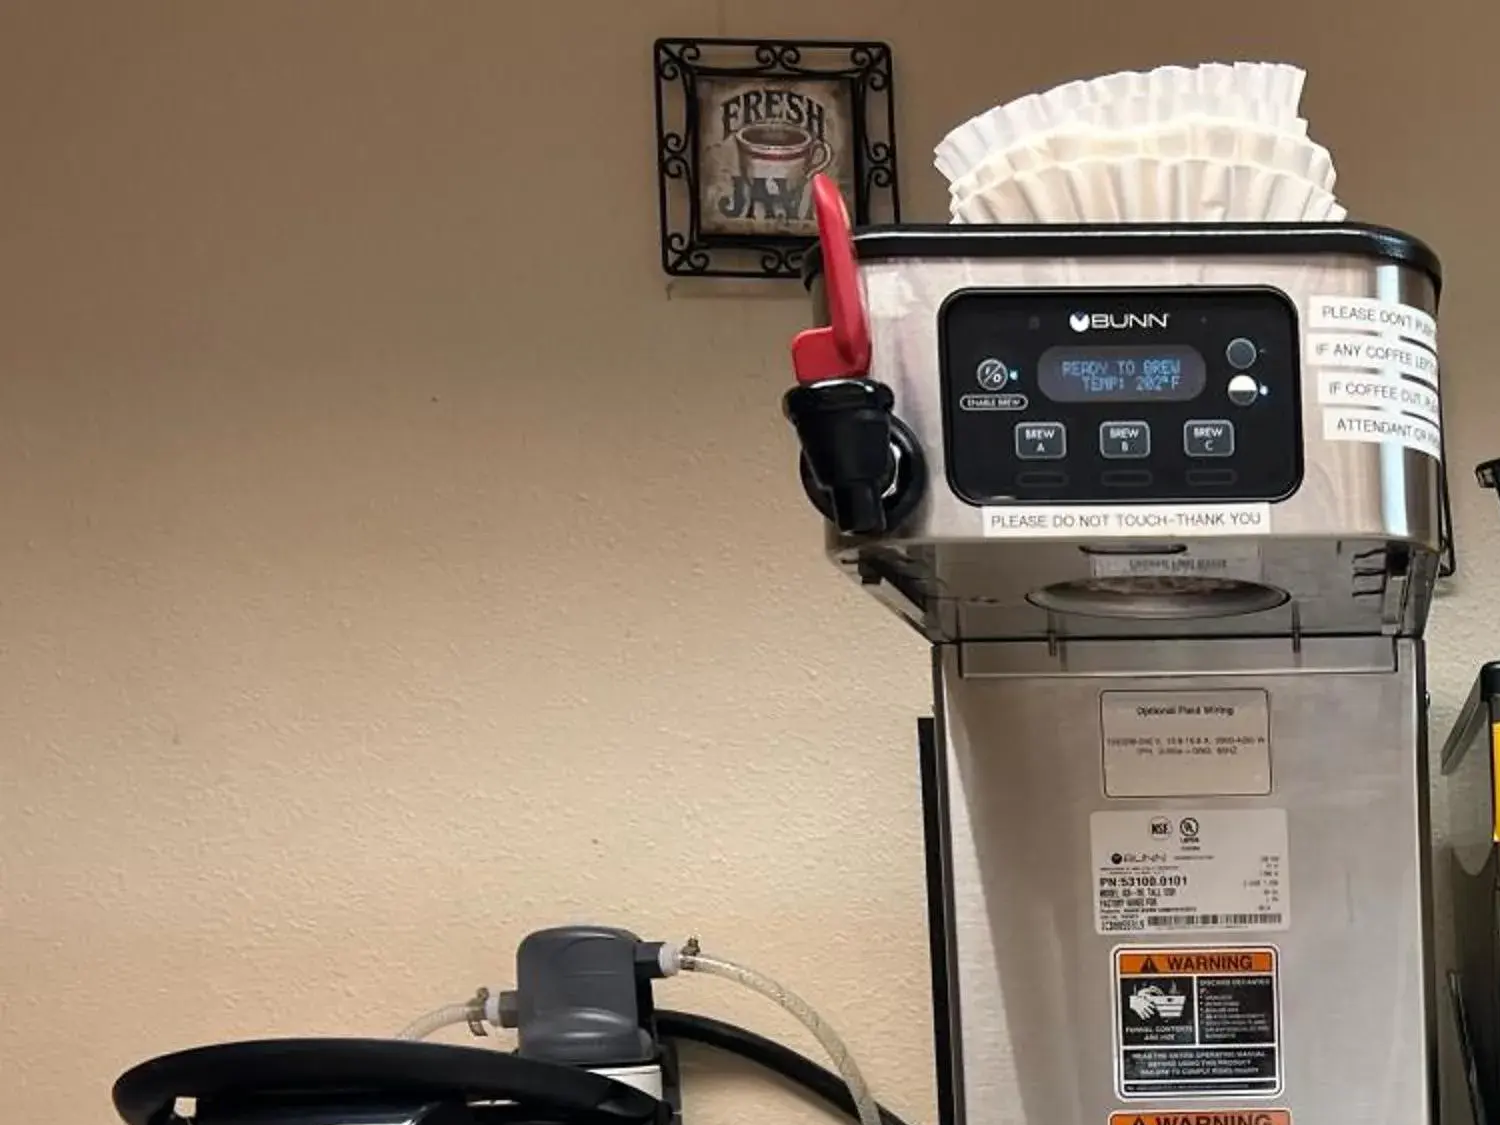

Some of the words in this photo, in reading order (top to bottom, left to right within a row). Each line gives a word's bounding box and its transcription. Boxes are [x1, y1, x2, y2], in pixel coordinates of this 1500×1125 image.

[720, 89, 825, 141] FRESH
[718, 176, 818, 221] JAV
[1091, 313, 1169, 329] BUNN
[1322, 305, 1376, 323] PLEASE
[1316, 343, 1329, 356] IF
[1334, 344, 1362, 356] ANY
[1366, 349, 1414, 365] COFFEE
[1118, 360, 1135, 375] TO
[1329, 381, 1343, 395] IF
[1345, 382, 1400, 400] COFFEE
[1025, 428, 1055, 440] BREW
[1109, 427, 1139, 439] BREW
[1193, 426, 1223, 439] BREW
[1336, 417, 1413, 438] ATTENDANT
[1036, 441, 1045, 453] A
[1121, 441, 1130, 453] B
[1204, 440, 1213, 452] C
[991, 515, 1047, 529] PLEASE
[1053, 515, 1074, 528] DO
[1079, 514, 1109, 527] NOT
[1229, 511, 1261, 525] YOU
[1167, 955, 1253, 971] WARNING
